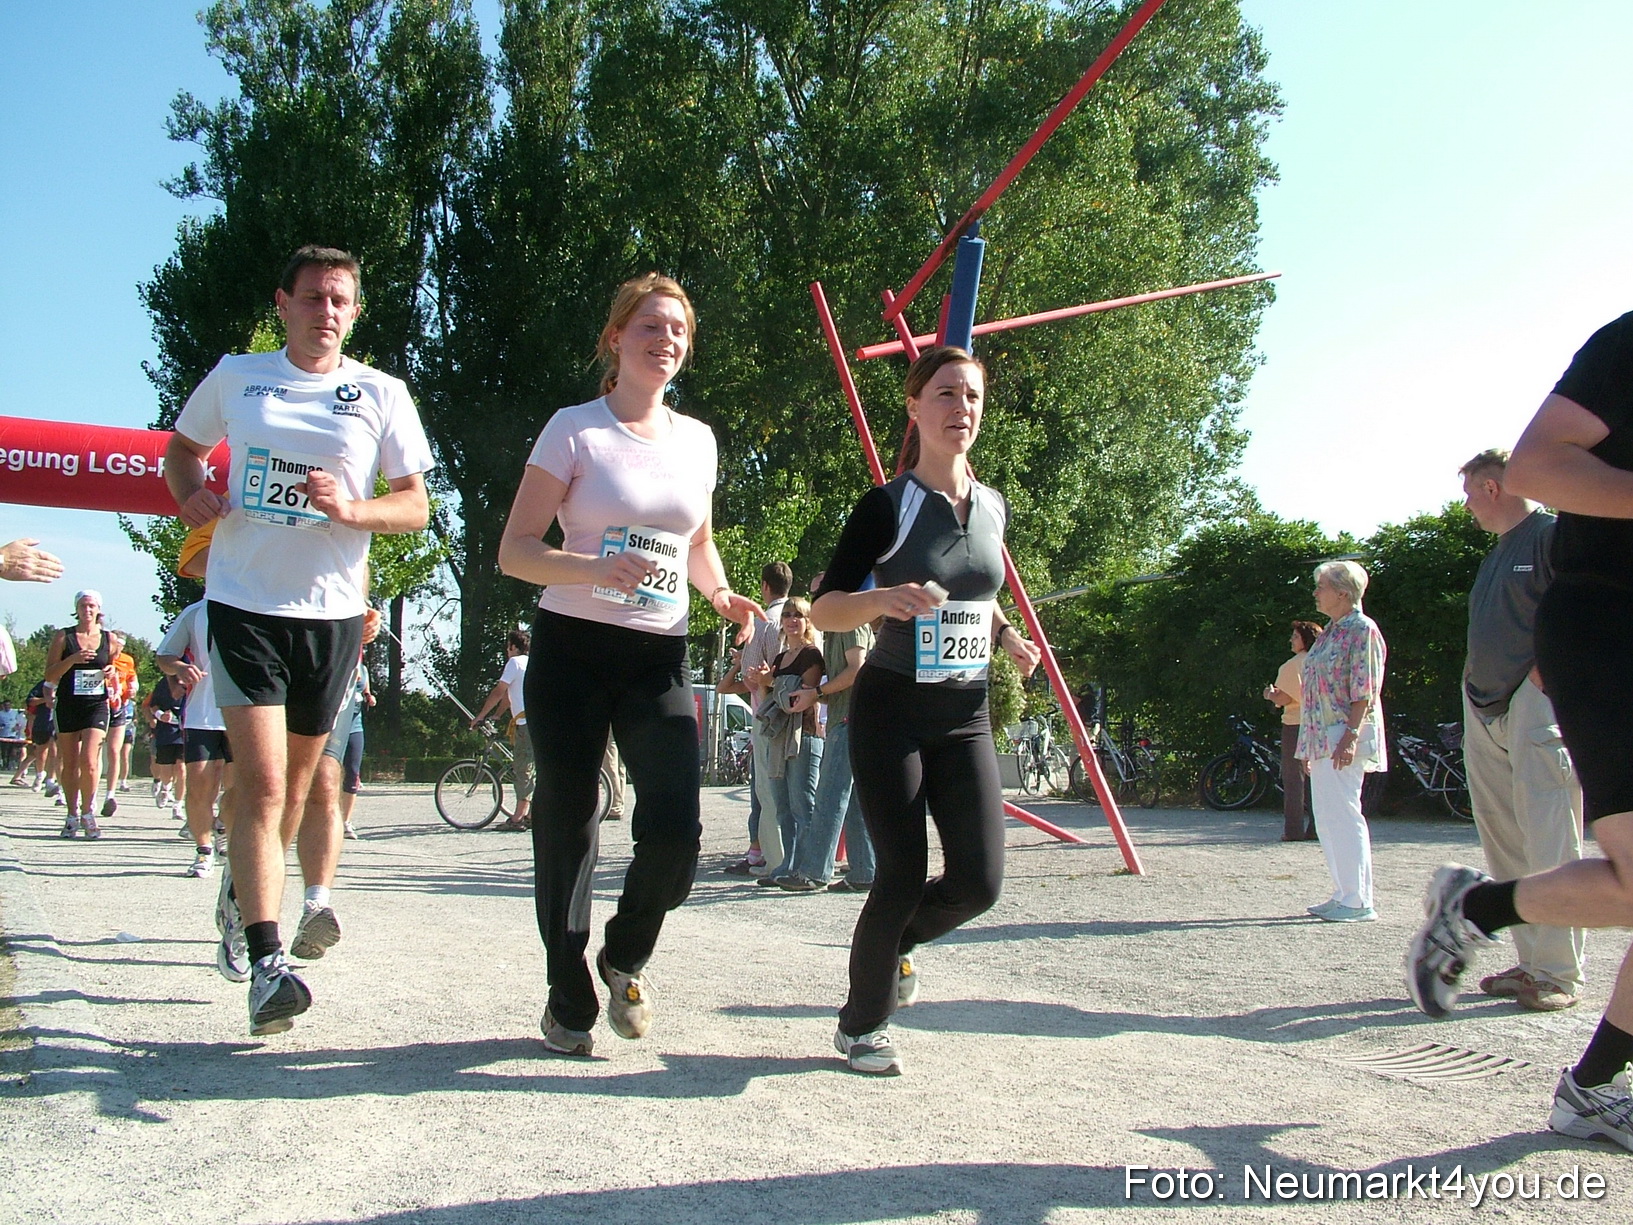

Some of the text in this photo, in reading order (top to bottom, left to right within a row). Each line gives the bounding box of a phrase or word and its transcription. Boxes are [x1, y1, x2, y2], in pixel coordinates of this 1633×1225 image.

[244, 384, 289, 395] ABRAHAM
[249, 475, 260, 487] C
[628, 533, 678, 559] Stefanie
[940, 609, 981, 625] Andrea
[922, 631, 933, 644] D
[942, 636, 987, 660] 2882
